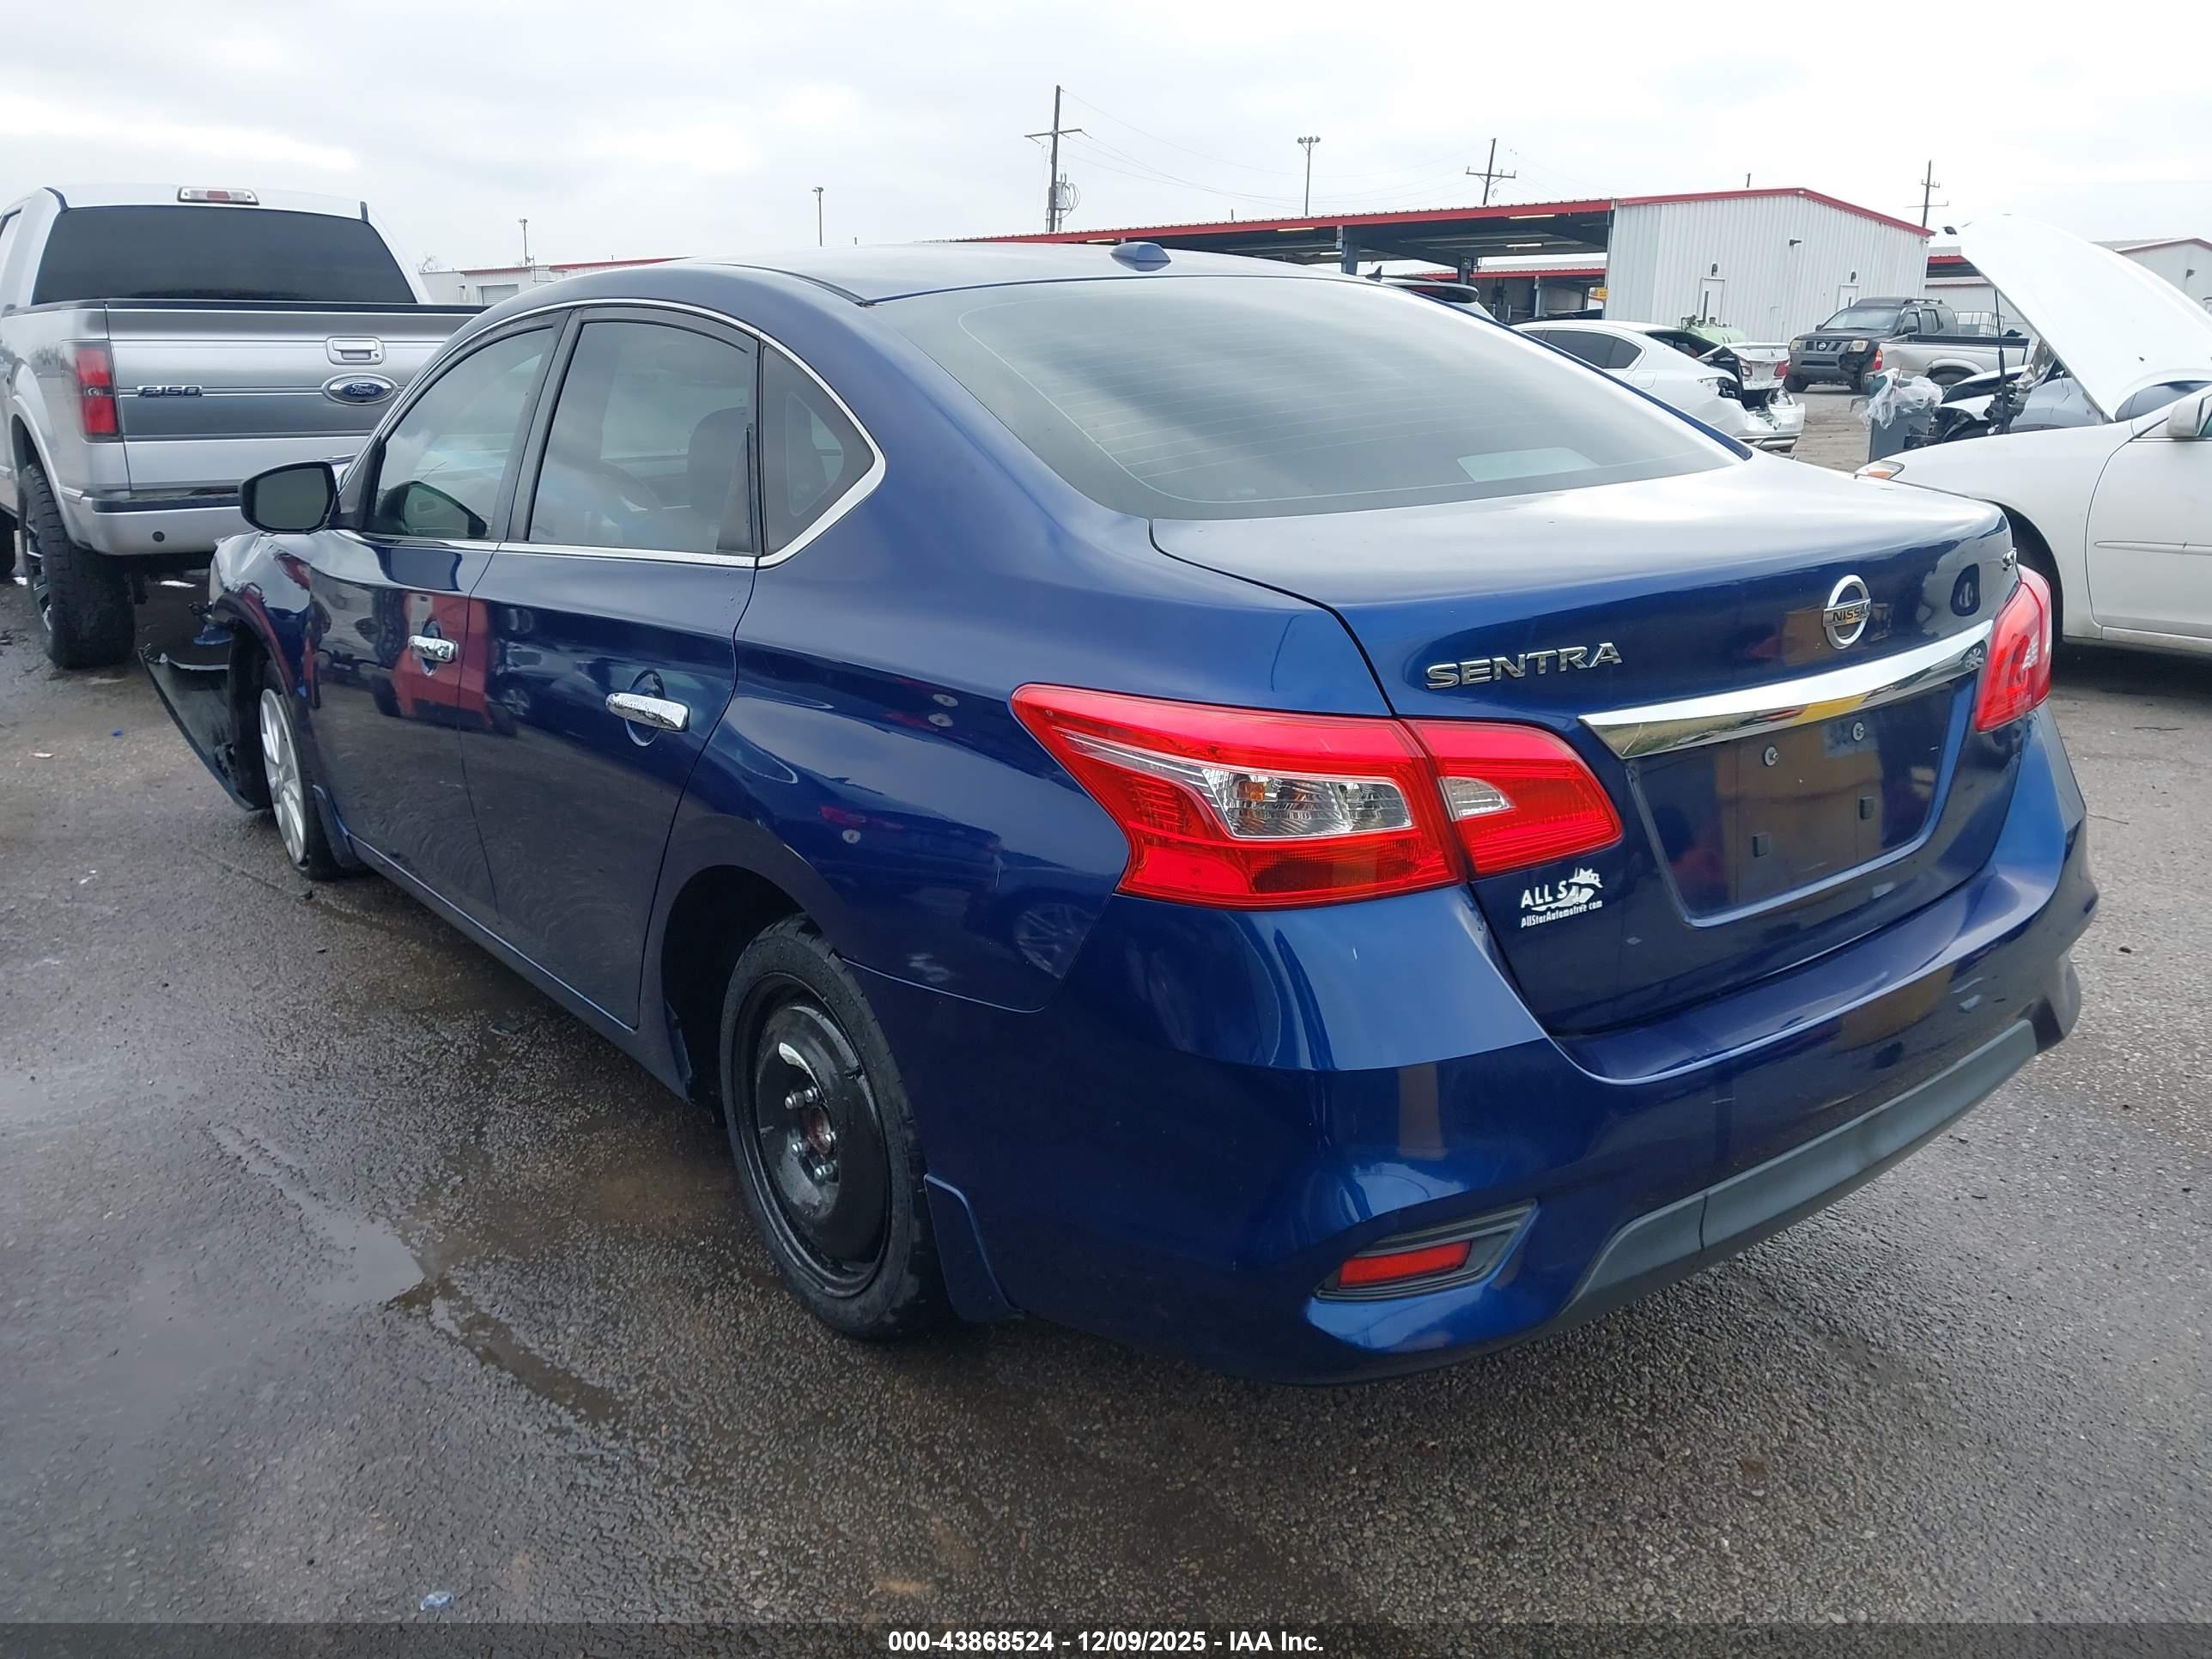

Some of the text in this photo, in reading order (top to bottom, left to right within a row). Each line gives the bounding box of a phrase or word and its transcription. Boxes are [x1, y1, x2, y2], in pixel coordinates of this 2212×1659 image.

[349, 383, 378, 395] Ford
[1425, 642, 1623, 690] SENTRA
[1520, 884, 1553, 908] ALL
